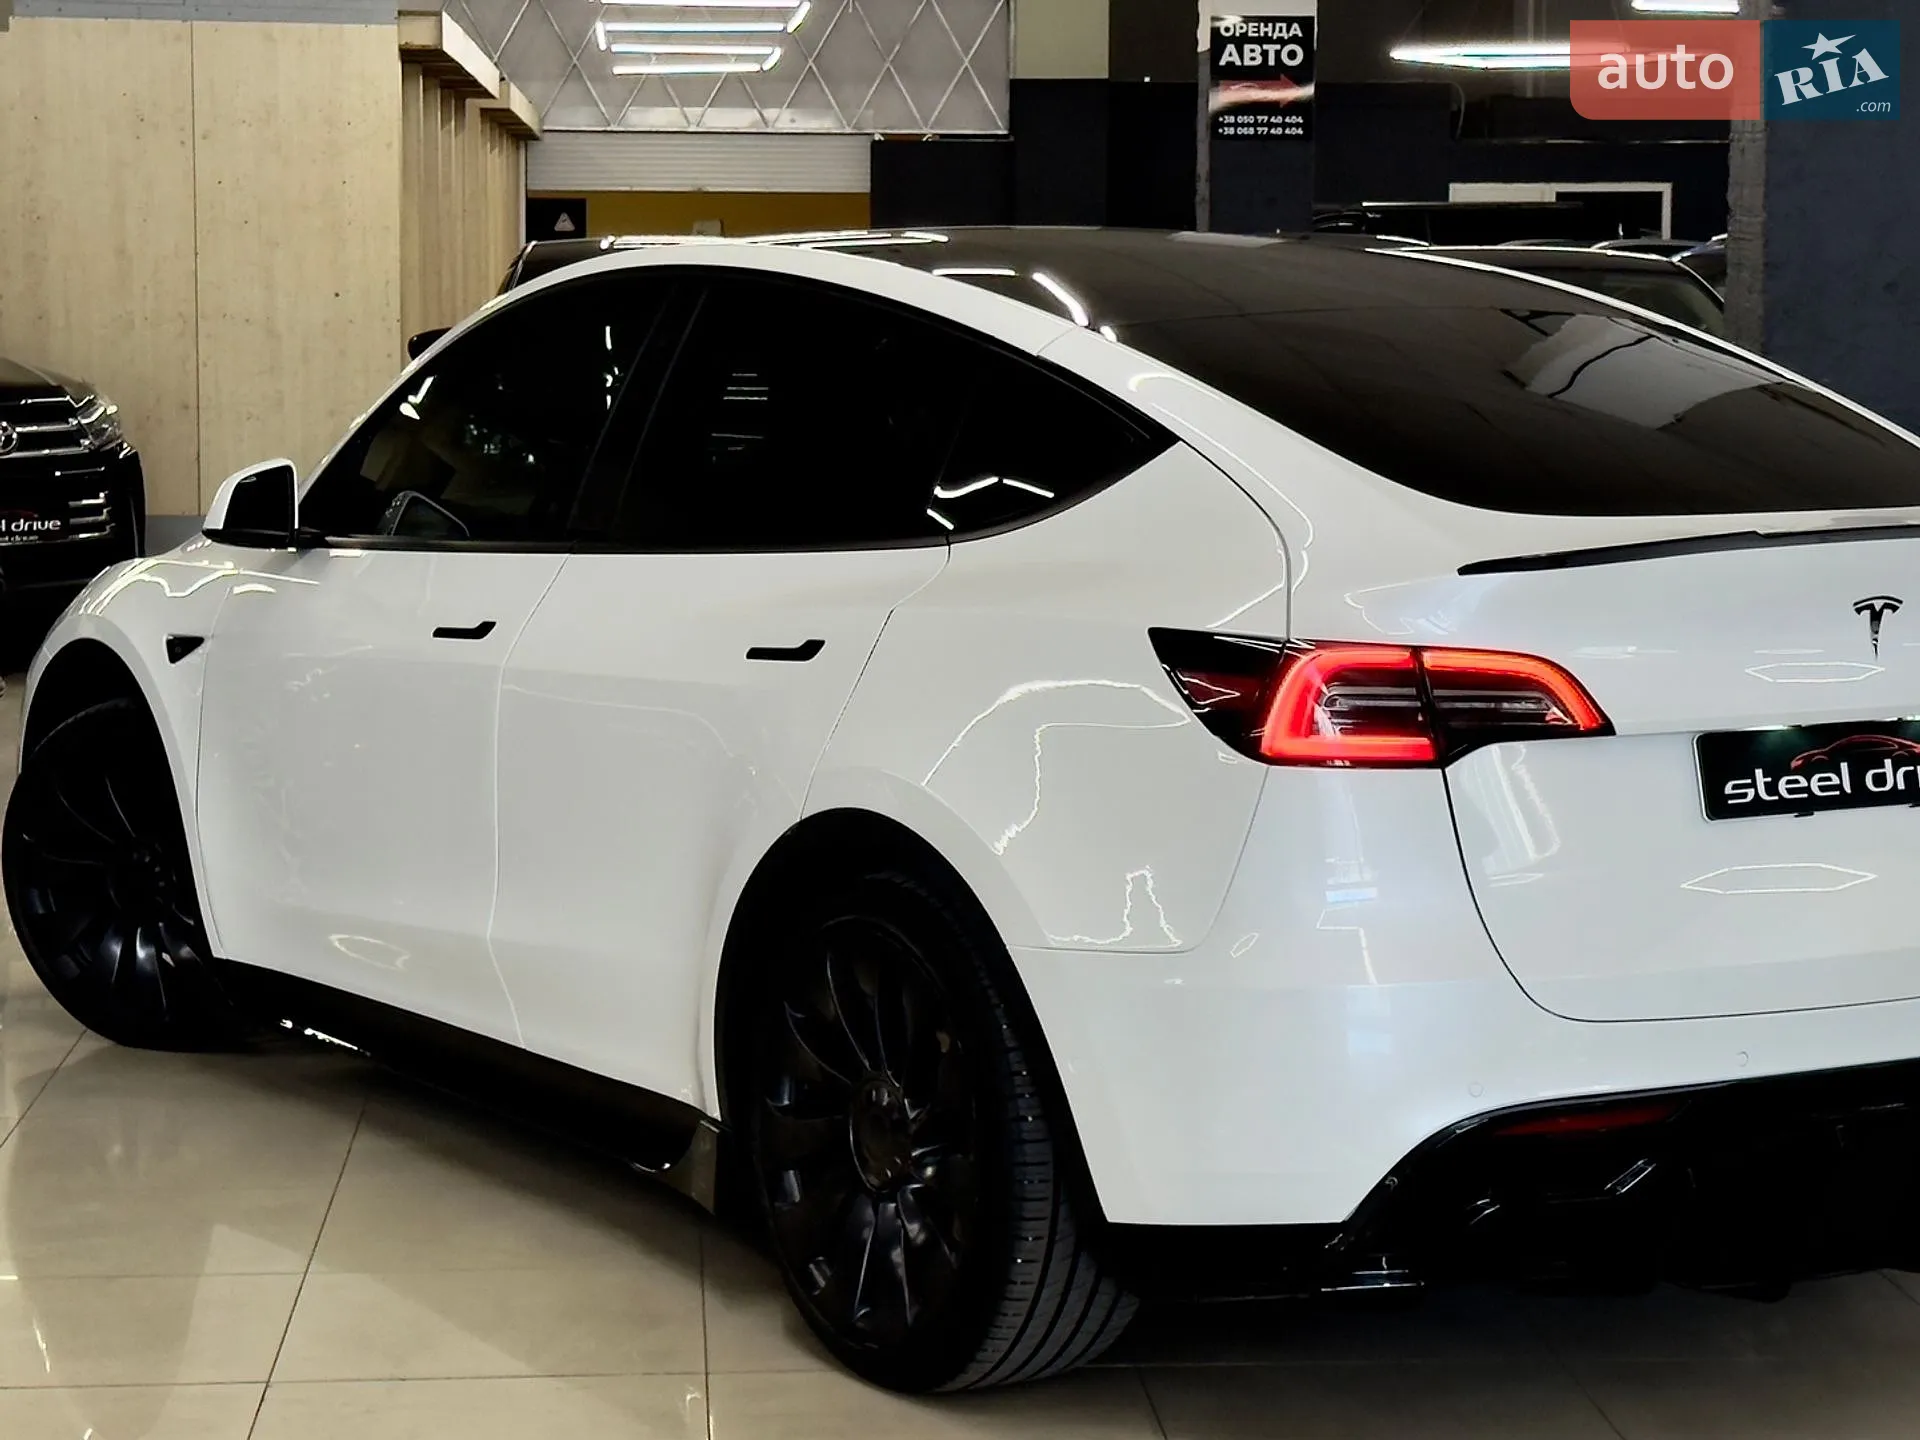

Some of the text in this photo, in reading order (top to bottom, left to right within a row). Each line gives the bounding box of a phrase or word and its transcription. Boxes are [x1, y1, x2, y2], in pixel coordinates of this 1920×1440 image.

[1219, 22, 1303, 40] ОРЕНДА
[1218, 43, 1304, 66] АВТО
[1237, 115, 1255, 124] 050
[1256, 115, 1268, 124] 77
[1270, 115, 1283, 124] 40
[1284, 115, 1304, 124] 404
[1256, 126, 1268, 135] 77
[1270, 126, 1283, 135] 40
[1284, 126, 1304, 135] 404
[11, 518, 61, 532] drive
[1724, 762, 1852, 804] steel
